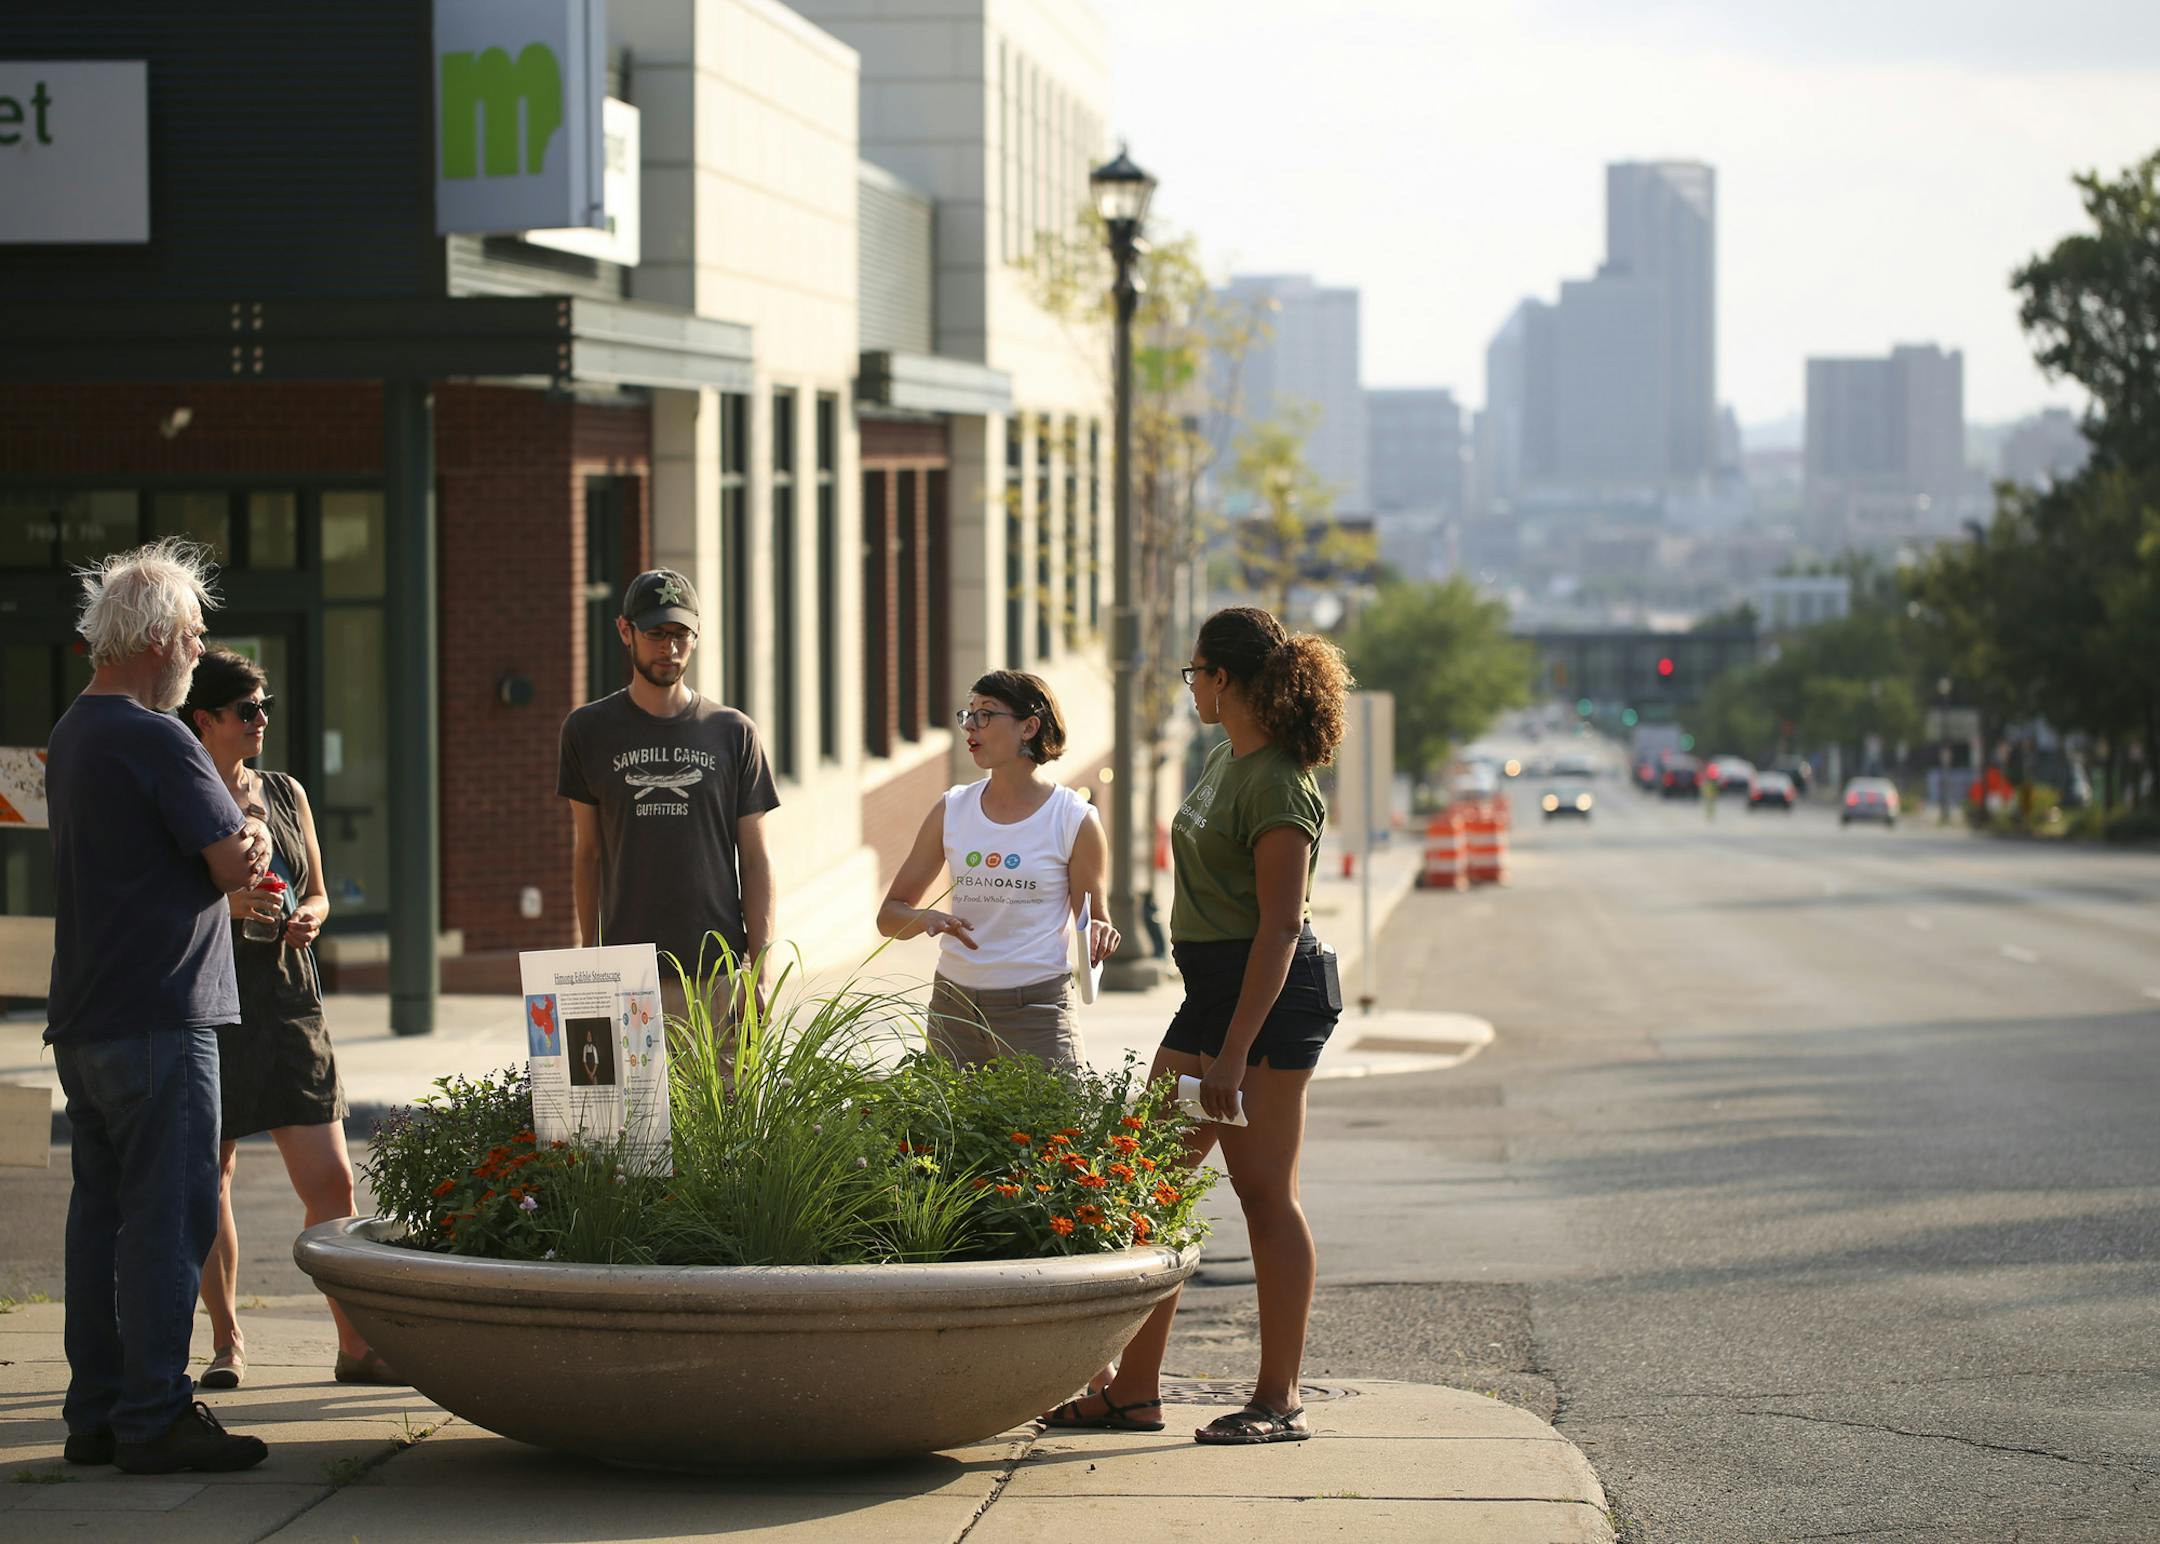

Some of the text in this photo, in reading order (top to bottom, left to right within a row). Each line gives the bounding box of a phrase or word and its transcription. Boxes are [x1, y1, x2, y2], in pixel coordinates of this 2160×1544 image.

[613, 747, 717, 772] SAWBILL CANOE
[636, 803, 689, 817] OUTFITTERS
[955, 876, 1037, 890] RBANOASIS
[984, 895, 1005, 904] Whole
